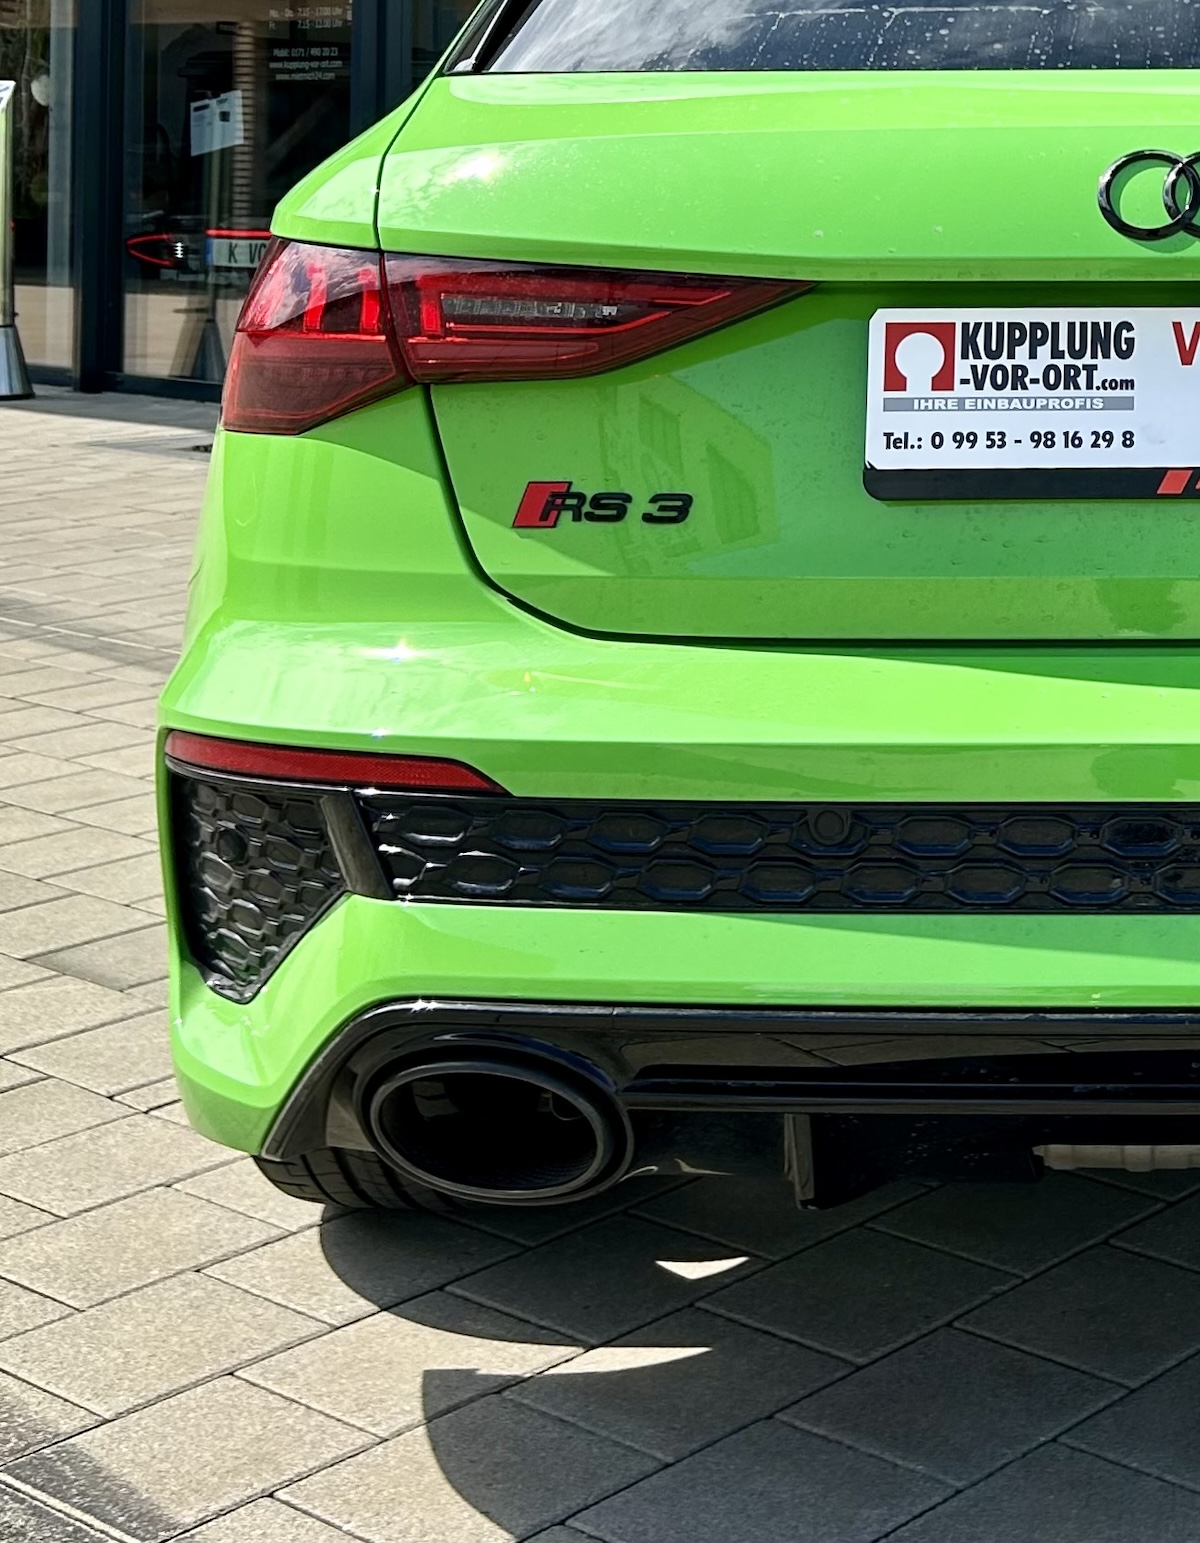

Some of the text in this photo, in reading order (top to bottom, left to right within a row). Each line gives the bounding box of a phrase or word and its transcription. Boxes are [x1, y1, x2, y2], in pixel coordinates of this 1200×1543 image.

[228, 242, 238, 264] K
[960, 320, 1136, 360] KUPPLUNG
[960, 364, 1136, 391] -VOR-ORT.com
[914, 398, 1104, 410] IHRE EINBAUPROFIS
[884, 432, 922, 450] Tel.:
[931, 432, 944, 449] 0
[952, 432, 978, 449] 99
[986, 432, 1007, 449] 53
[1030, 430, 1056, 449] 98
[1063, 430, 1083, 448] 16
[1090, 430, 1114, 448] 29
[1122, 430, 1135, 448] 8
[538, 492, 694, 524] RS 3
